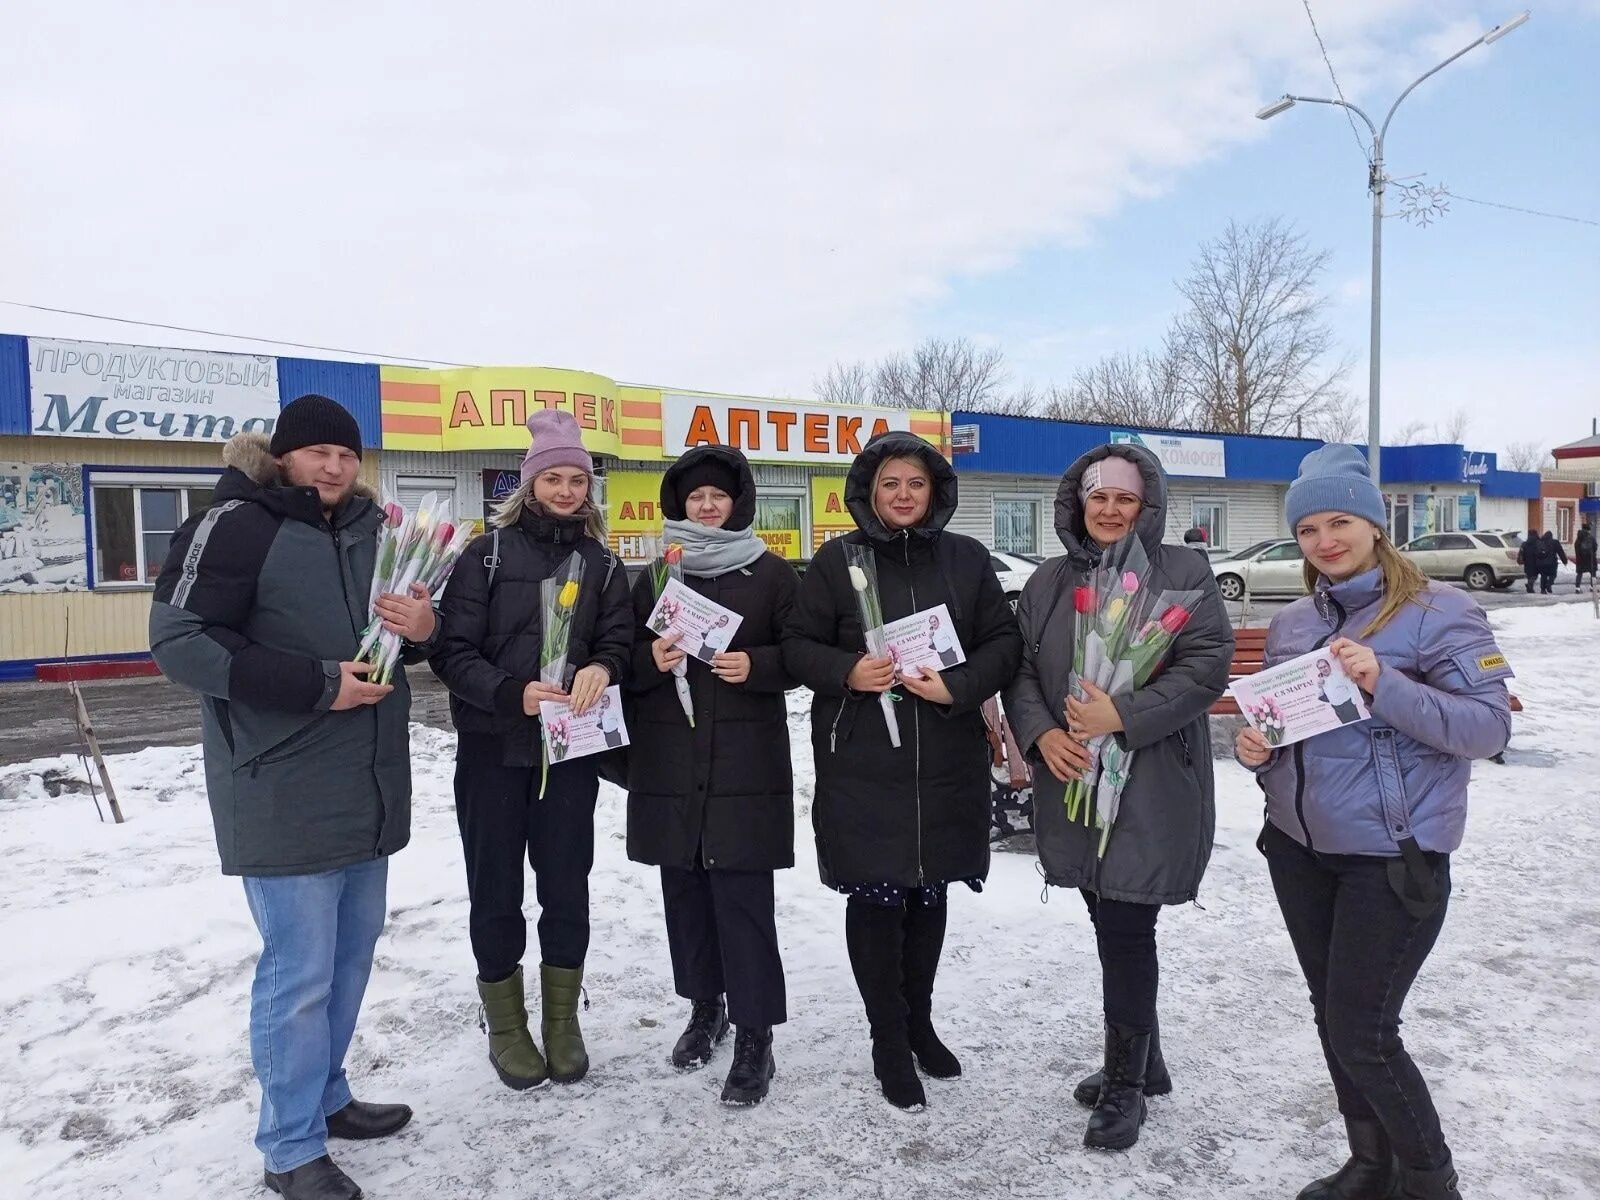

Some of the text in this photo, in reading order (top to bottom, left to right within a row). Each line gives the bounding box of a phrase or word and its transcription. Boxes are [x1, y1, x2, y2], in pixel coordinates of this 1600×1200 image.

[36, 347, 271, 388] ПРОДУКТОВЫЙ
[113, 384, 214, 404] магазин
[35, 393, 276, 440] Мечта
[185, 542, 203, 580] adidas
